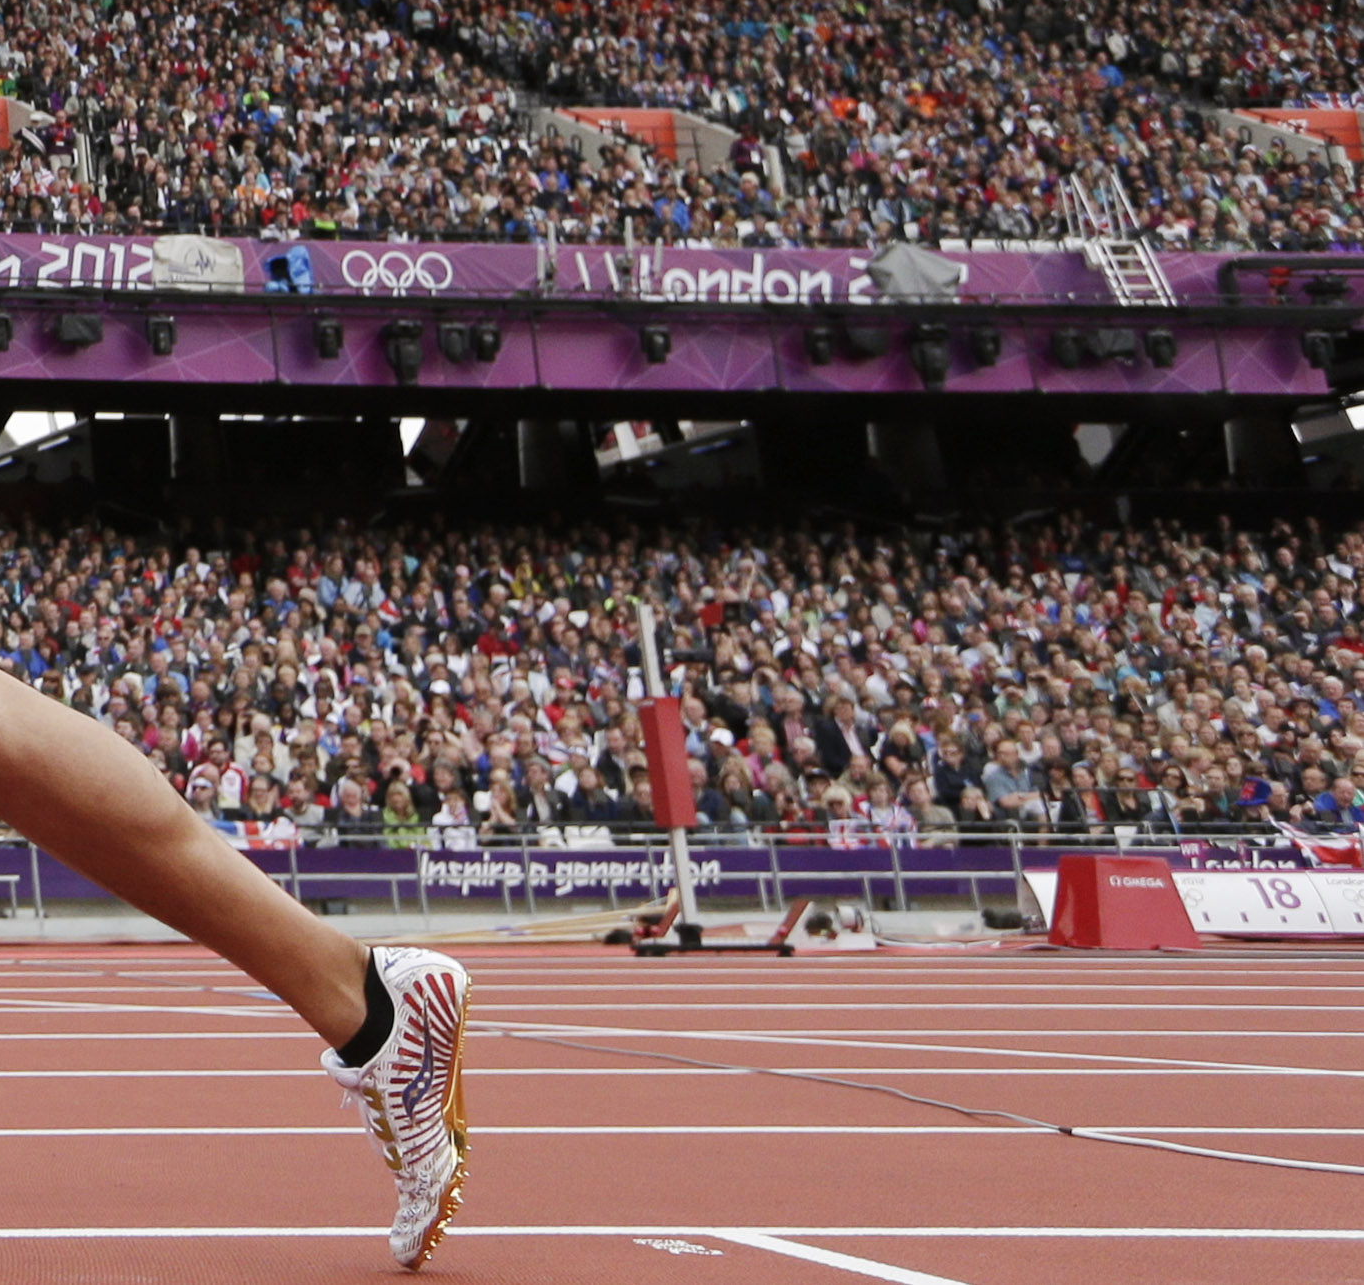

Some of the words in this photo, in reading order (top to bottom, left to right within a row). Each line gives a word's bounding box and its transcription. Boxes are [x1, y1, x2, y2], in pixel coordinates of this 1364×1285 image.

[36, 241, 154, 291] 2012
[639, 253, 833, 305] London
[421, 850, 523, 897] Inspire
[528, 861, 550, 886] a
[554, 851, 722, 897] generaton
[1122, 876, 1165, 889] OMEGA
[1248, 877, 1302, 910] 18
